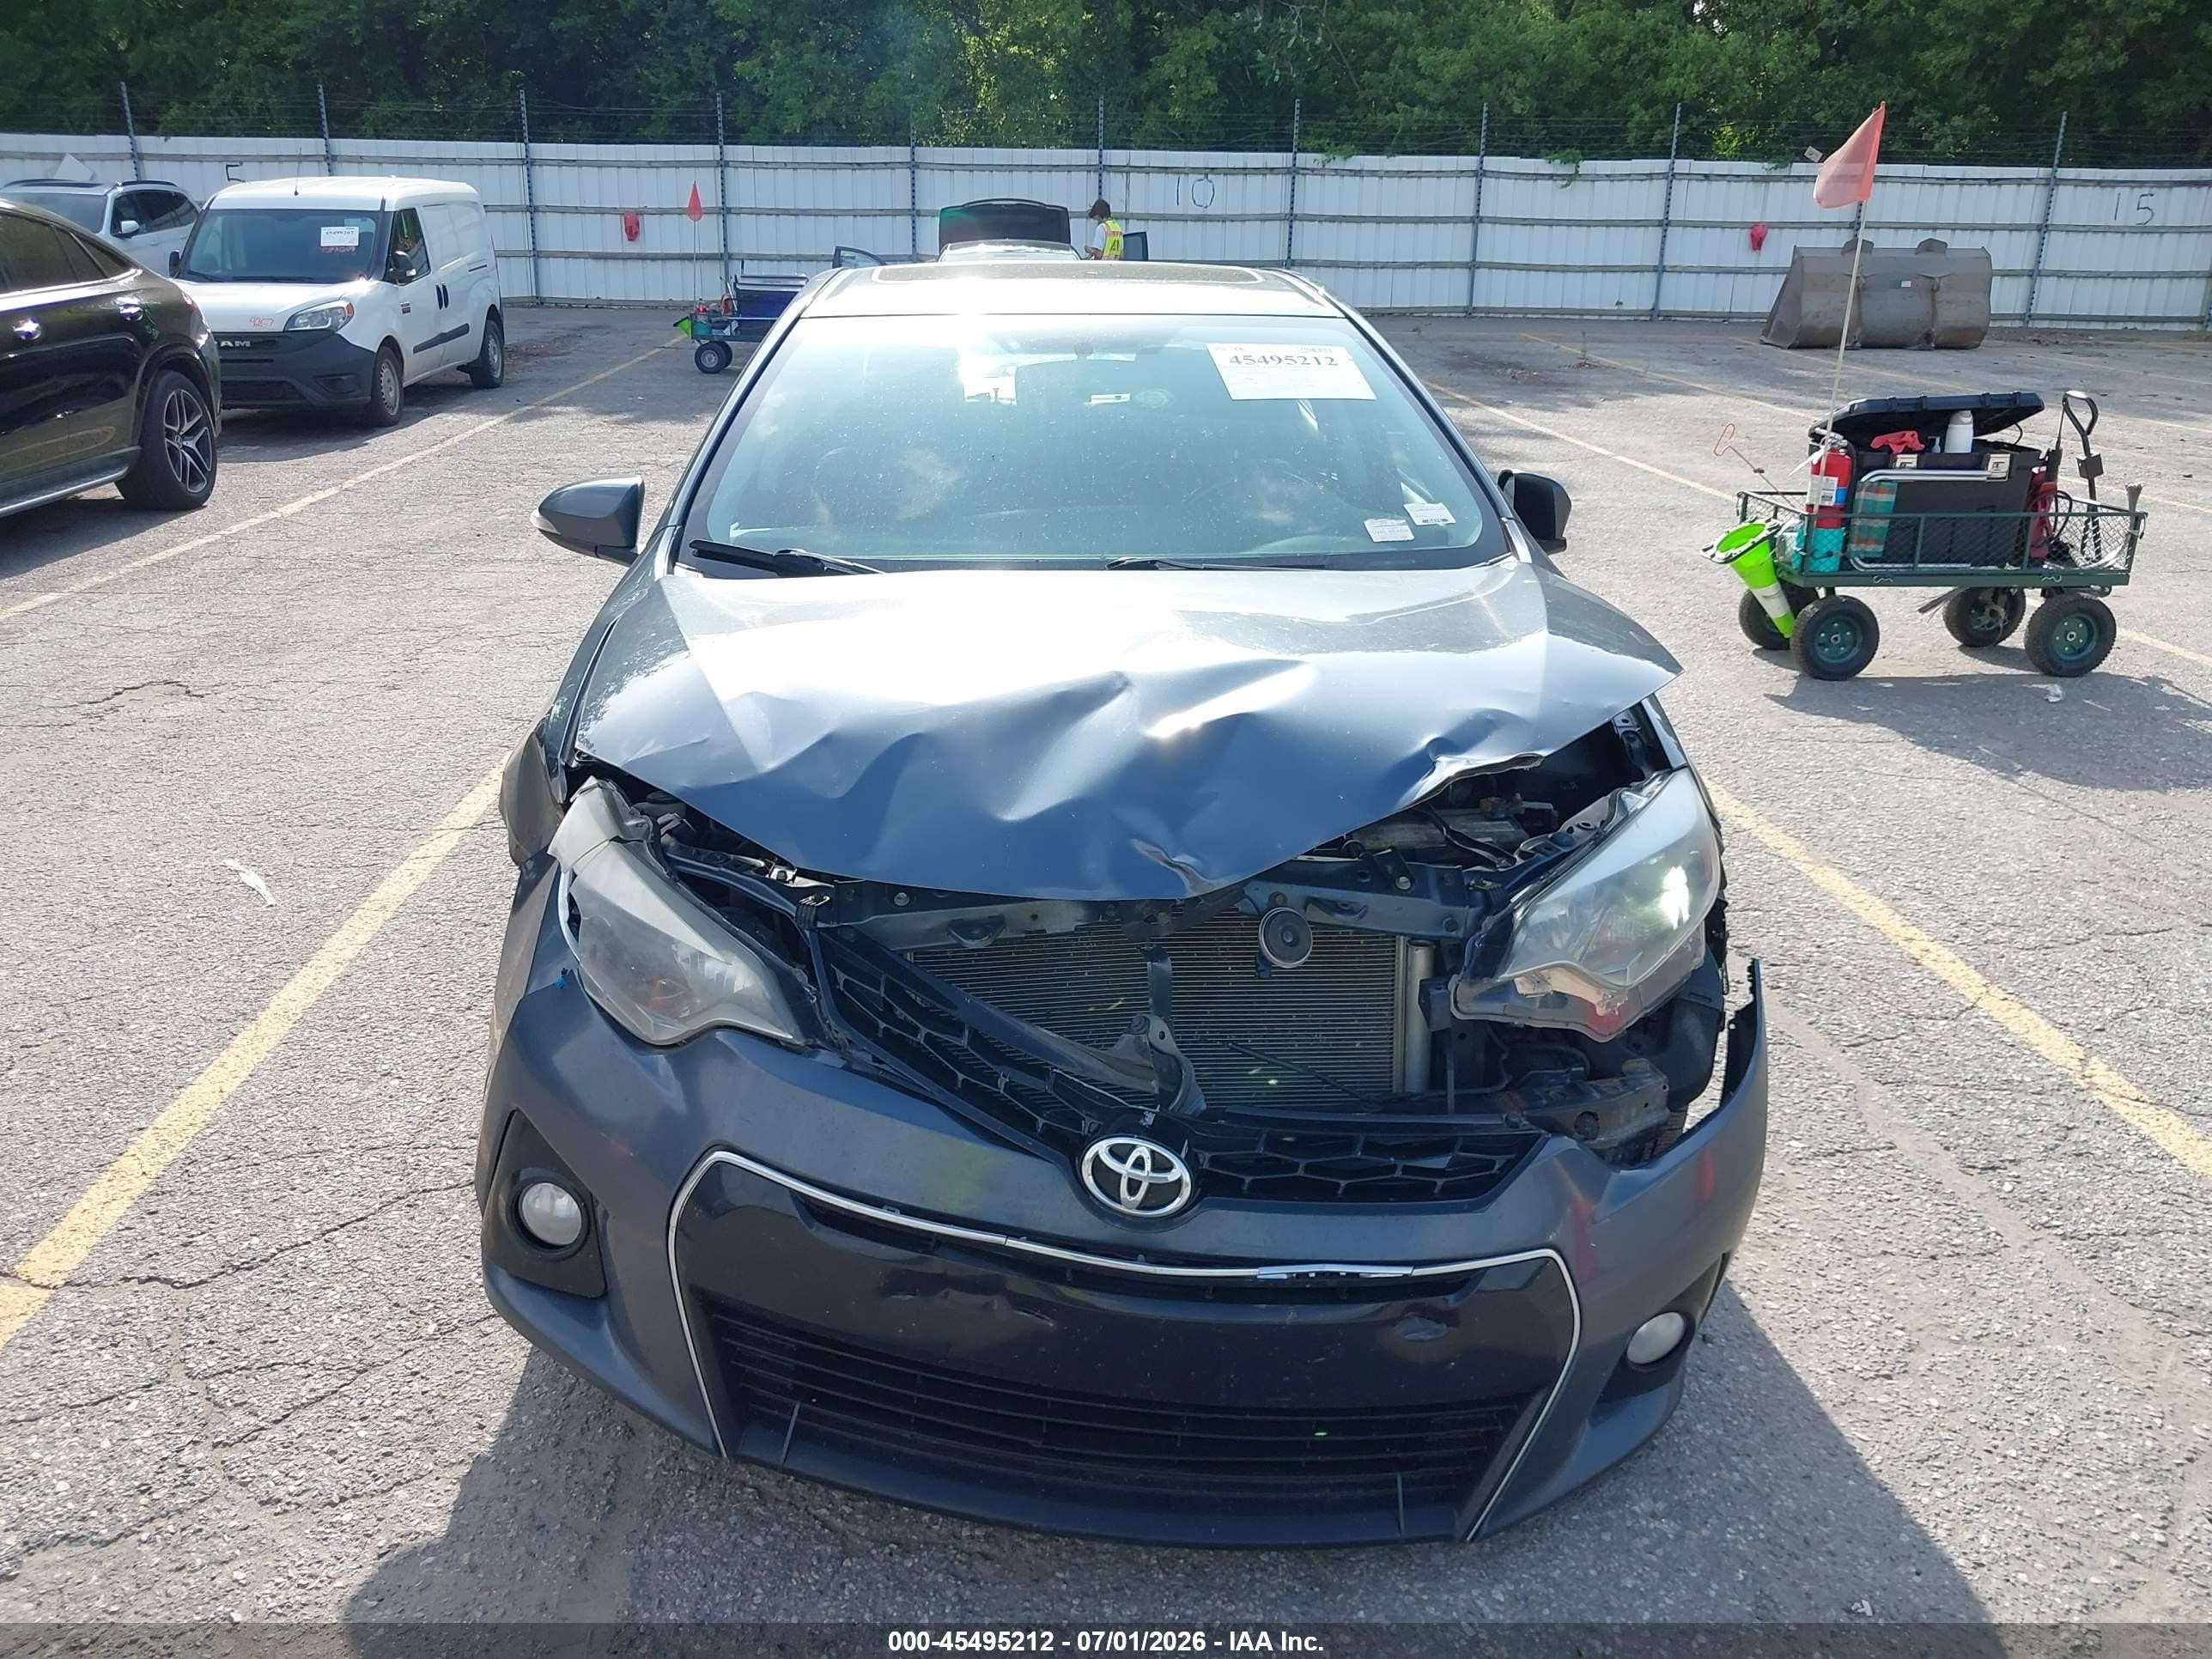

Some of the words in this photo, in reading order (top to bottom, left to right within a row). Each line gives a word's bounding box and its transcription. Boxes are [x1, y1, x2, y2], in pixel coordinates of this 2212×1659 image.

[1176, 175, 1215, 209] 10
[2114, 192, 2154, 226] 15
[1229, 354, 1339, 367] 45495212
